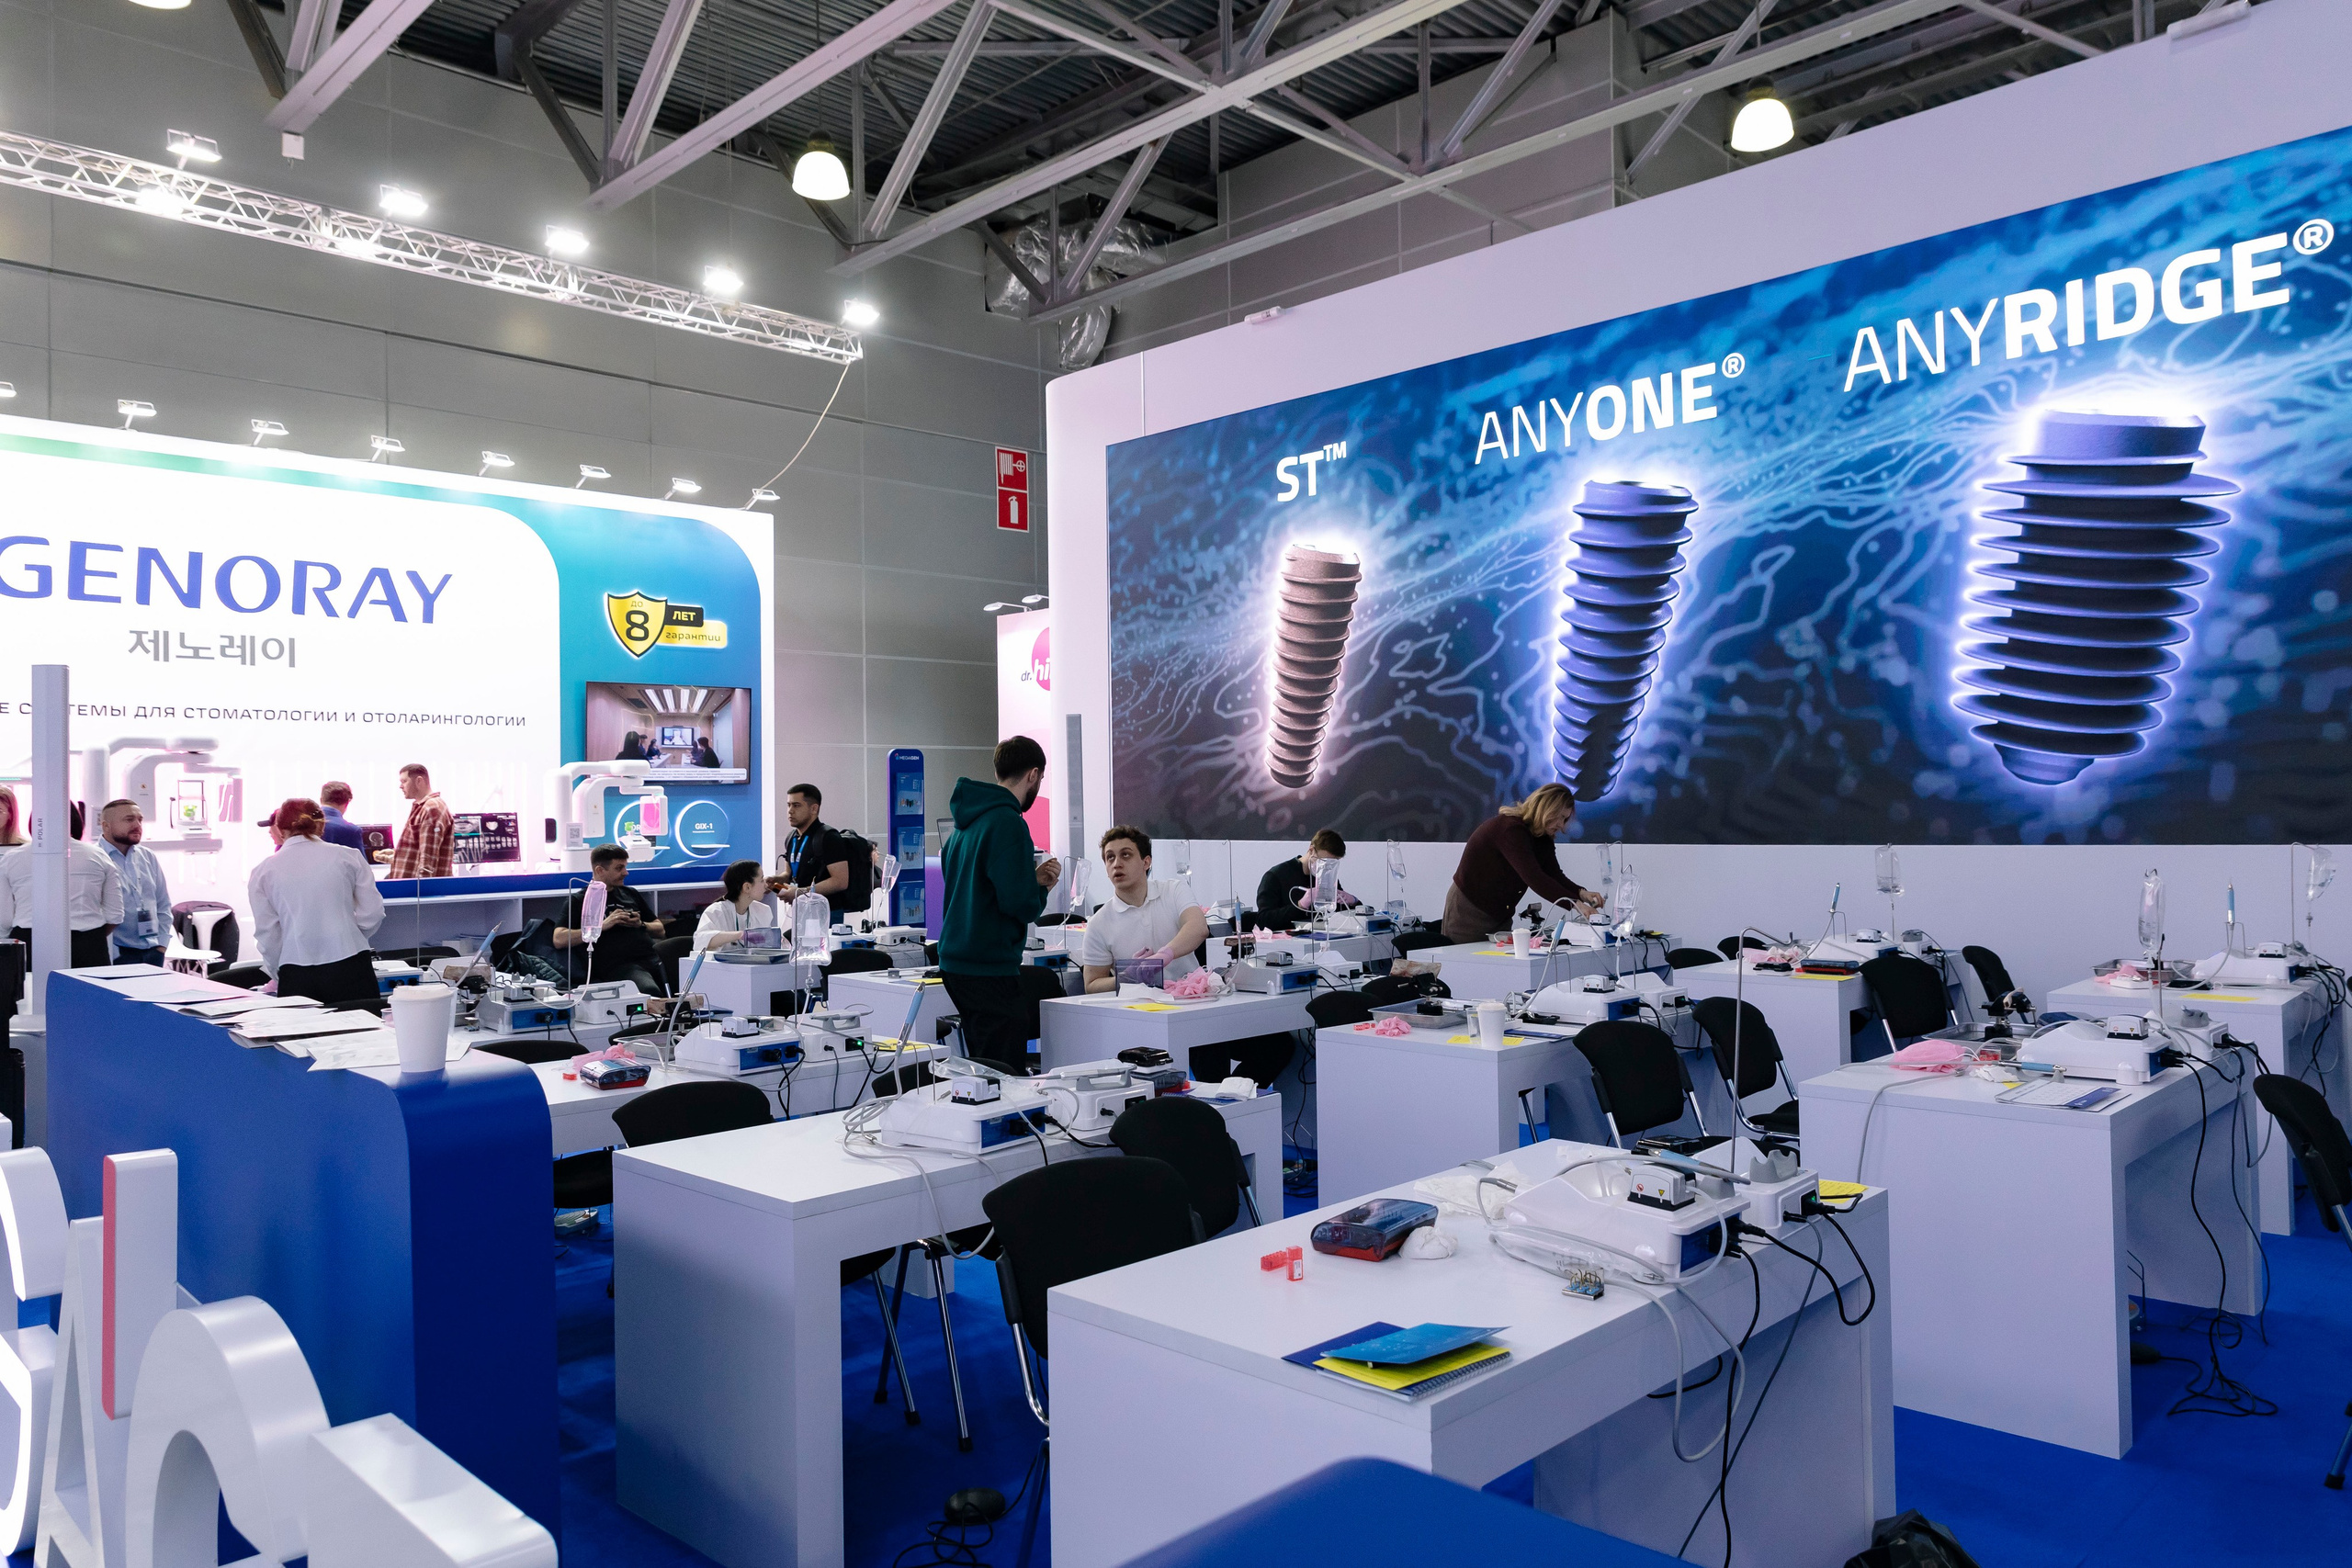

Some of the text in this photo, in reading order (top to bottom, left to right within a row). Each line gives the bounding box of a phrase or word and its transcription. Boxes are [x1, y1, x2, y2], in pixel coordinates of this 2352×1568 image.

[0, 535, 453, 625] GENORAY
[626, 610, 650, 641] 8
[673, 610, 696, 622] ЛЕТ
[665, 631, 721, 642] гарантии
[128, 629, 296, 669] 제노레이
[1034, 658, 1050, 682] hi
[18, 703, 126, 716] СТЕМЫ
[133, 705, 175, 719] ДЛЯ
[183, 706, 338, 722] СТОМАТОЛОГИИ
[345, 711, 356, 723] И
[362, 712, 526, 727] ОТОЛАРИНГОЛОГИИ
